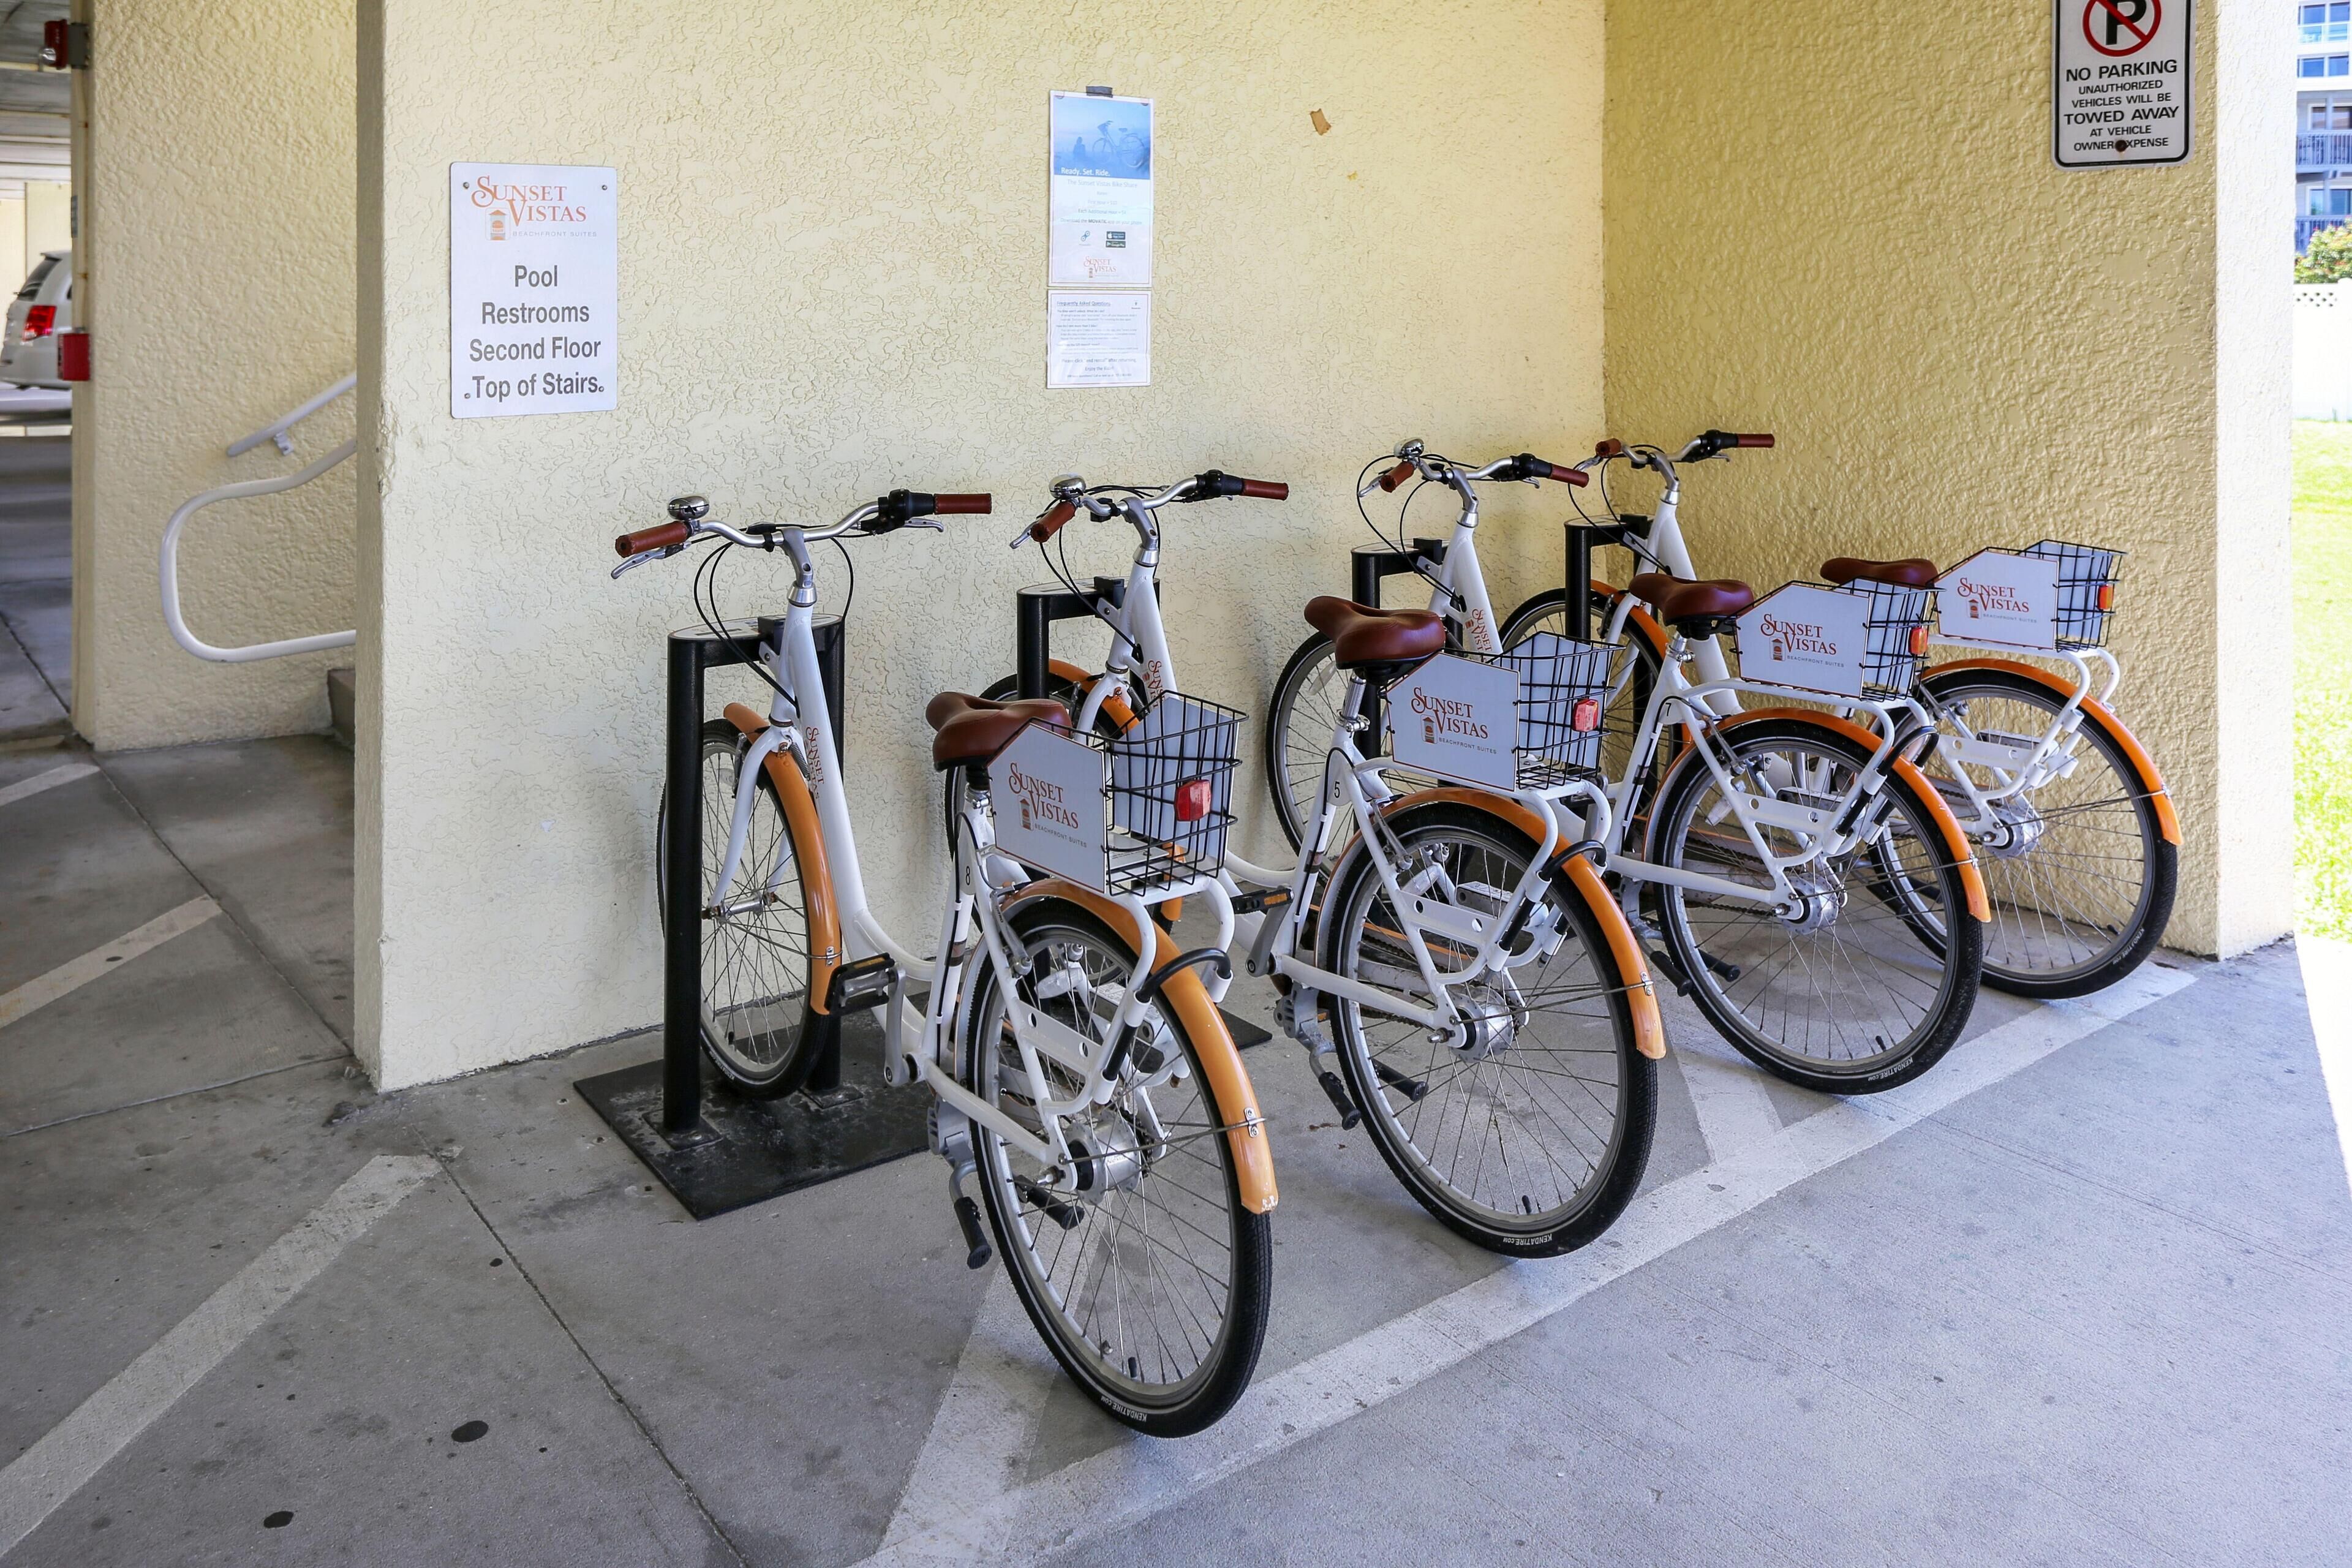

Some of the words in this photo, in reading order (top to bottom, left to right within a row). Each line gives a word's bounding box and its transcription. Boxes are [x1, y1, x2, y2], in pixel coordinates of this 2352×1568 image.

[2066, 67, 2091, 82] NO
[2098, 59, 2177, 79] PARKING
[2078, 80, 2163, 95] UNAUTHORIZED
[2071, 97, 2122, 108] VEHICLES
[2126, 94, 2153, 104] WILL
[2157, 92, 2171, 102] BE
[2064, 110, 2124, 125] TOWED
[2131, 106, 2179, 121] AWAY
[2089, 128, 2103, 137] AT
[2107, 125, 2152, 136] VEHICLE
[2119, 137, 2169, 149] XPENSE
[1061, 167, 1082, 176] Ready.
[471, 175, 567, 208] SUNSET
[506, 198, 587, 227] VISTAS
[1084, 255, 1112, 268] SUNSET
[1093, 264, 1117, 273] VISTAS
[514, 265, 558, 287] Pool
[482, 301, 590, 324] Restrooms
[470, 337, 545, 361] Second
[552, 336, 601, 358] Floor
[472, 376, 510, 402] Top
[518, 374, 537, 396] of
[542, 372, 598, 395] Stairs
[1957, 578, 2015, 598] SUNSET
[1979, 593, 2029, 613] VISTAS
[1472, 609, 1492, 651] SUNSET
[1760, 614, 1823, 638] SUNSET
[1782, 631, 1837, 655] VISTAS
[1787, 655, 1823, 665] BEACHFRONT
[1411, 687, 1473, 719] SUNSET
[1665, 703, 1672, 717] 7
[1432, 709, 1489, 739] VISTAS
[805, 726, 824, 784] SUNSET
[1438, 737, 1476, 750] BEACHFRONT
[1477, 745, 1498, 755] SUITES
[1009, 762, 1064, 804] SUNSET
[1334, 780, 1340, 798] 5
[1028, 791, 1079, 829] VISTAS
[1035, 823, 1068, 840] BEACHFRONT
[1068, 835, 1088, 848] SUITES
[965, 865, 971, 886] 8
